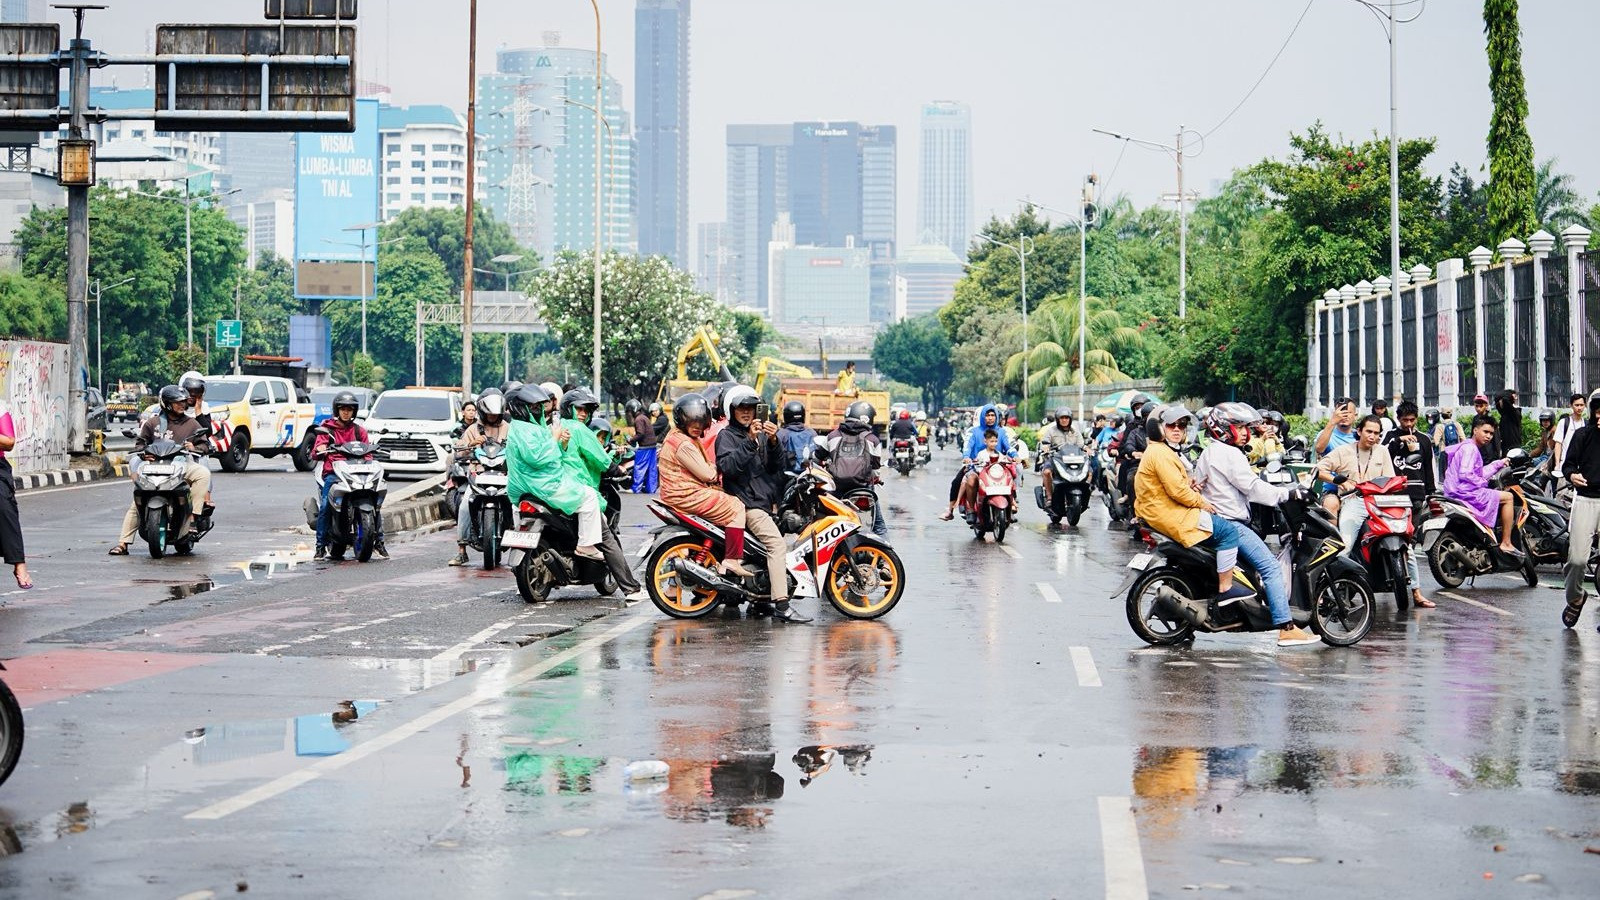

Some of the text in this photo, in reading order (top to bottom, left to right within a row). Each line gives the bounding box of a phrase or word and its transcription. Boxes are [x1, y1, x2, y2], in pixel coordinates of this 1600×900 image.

[321, 135, 354, 153] WISMA
[300, 157, 374, 176] LUMBA-LUMBA
[321, 178, 353, 198] TNI AL
[794, 523, 848, 563] REPSOL
